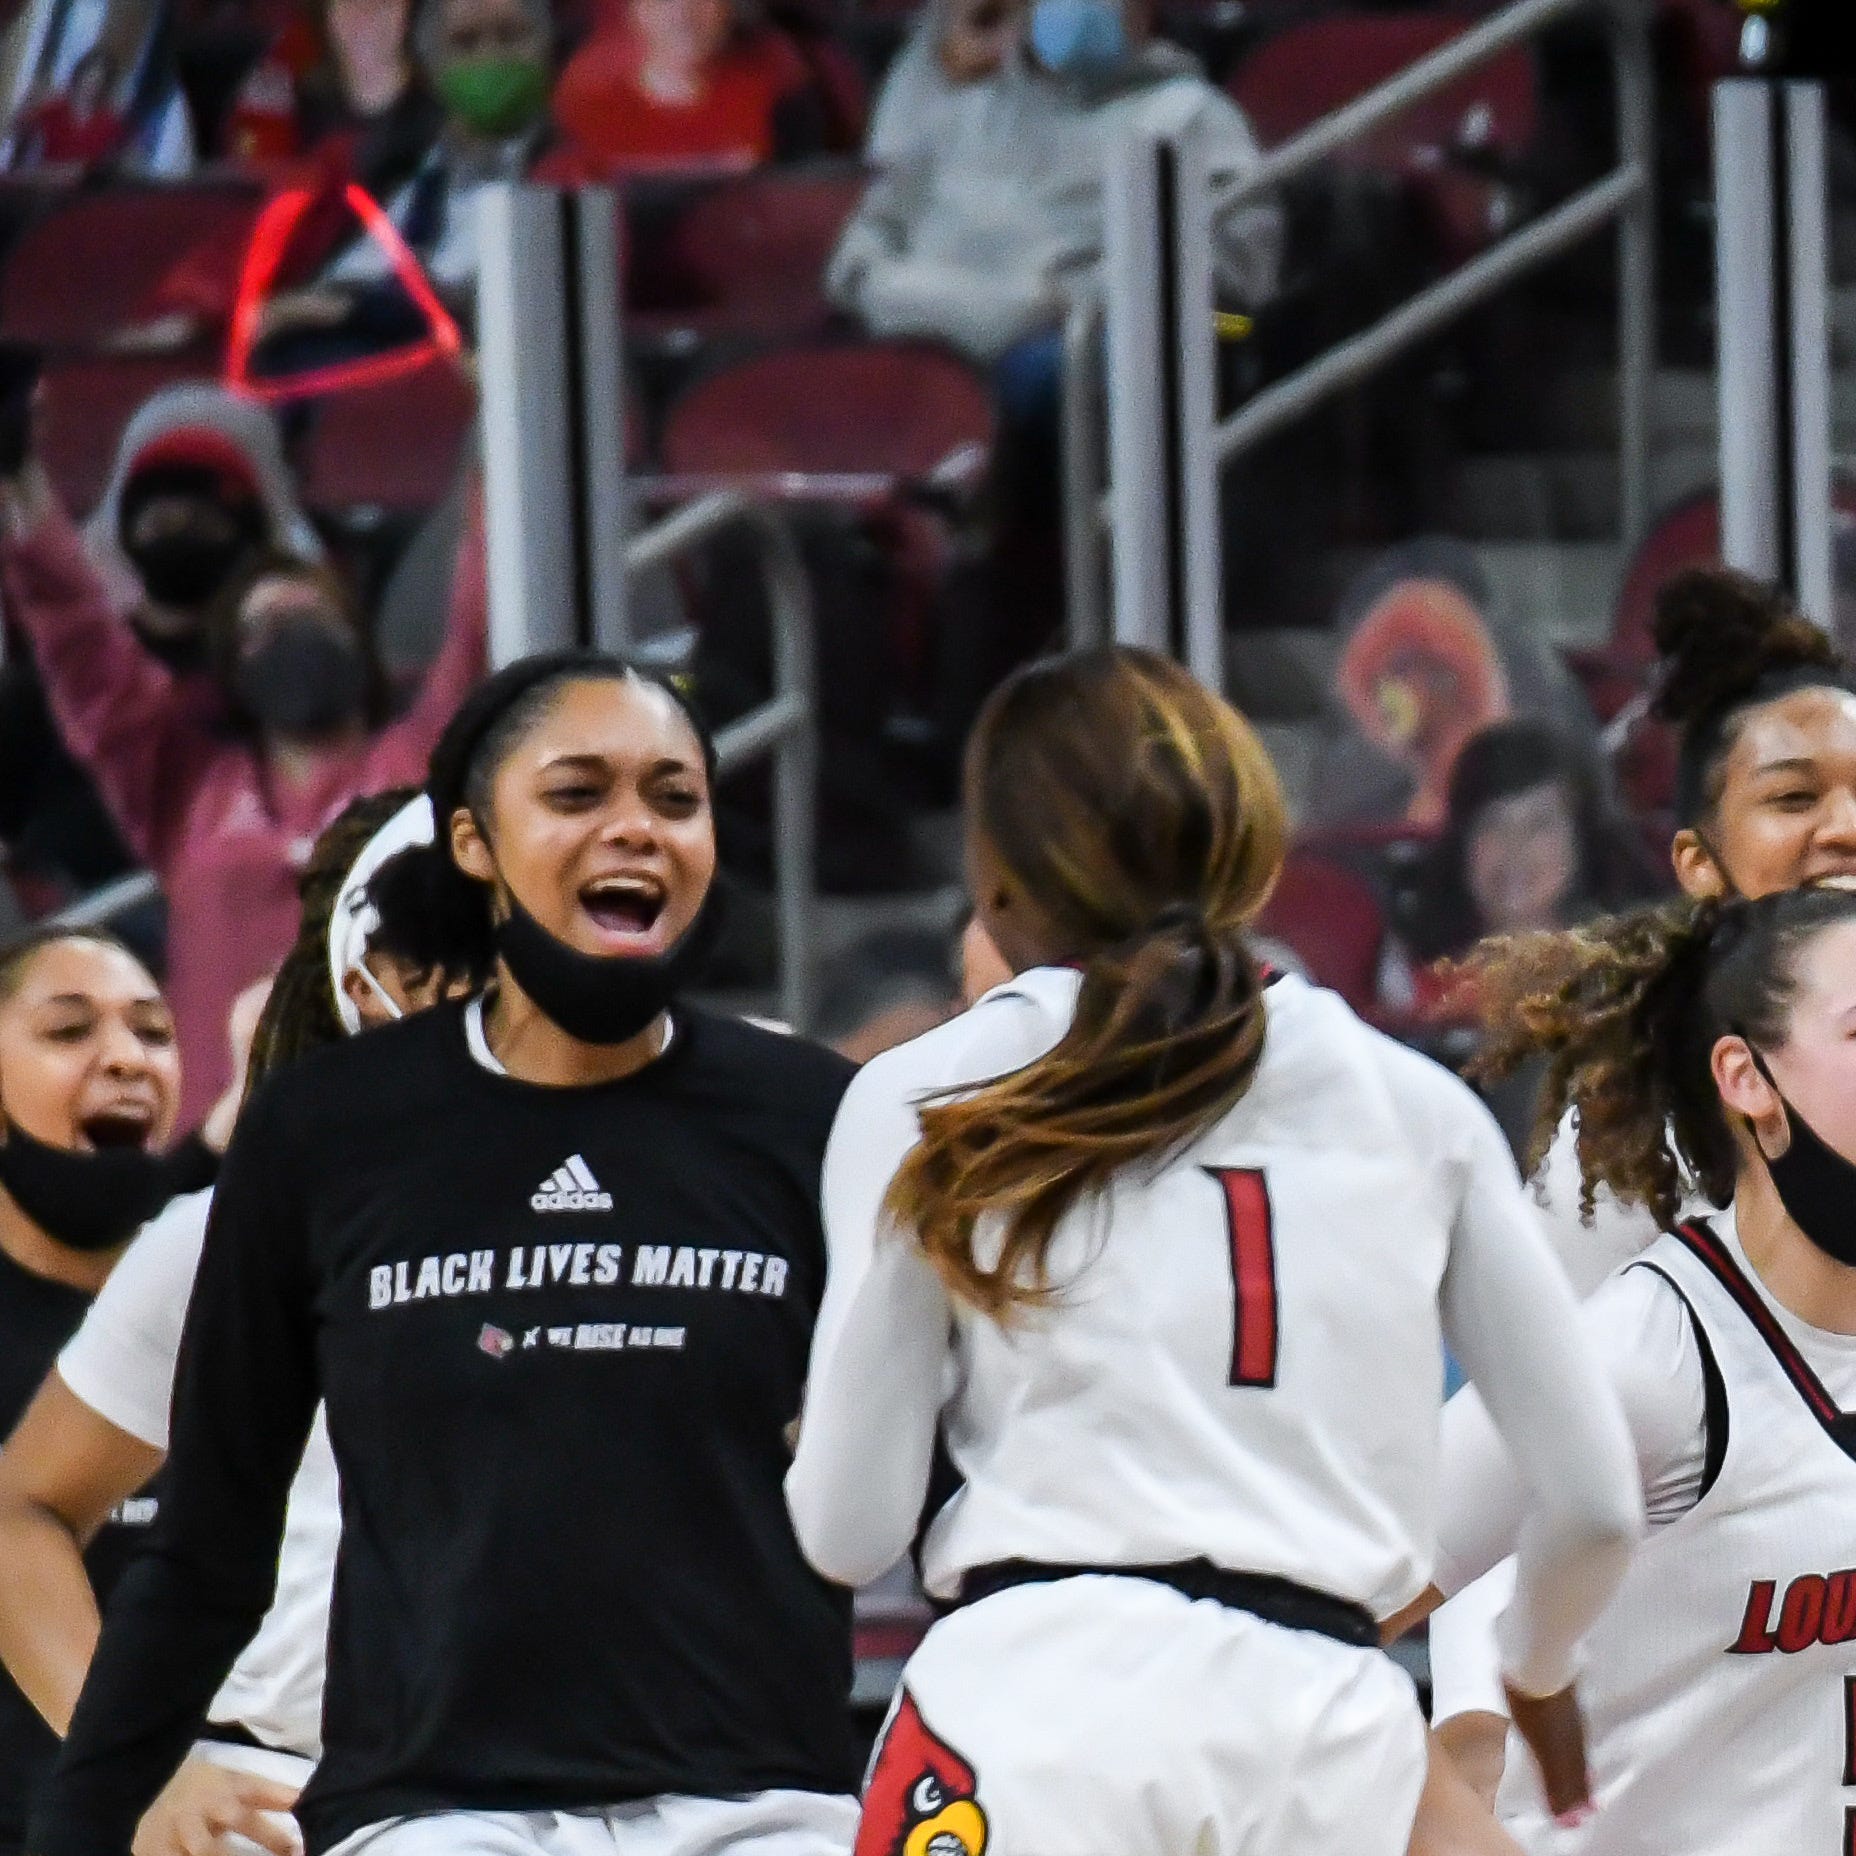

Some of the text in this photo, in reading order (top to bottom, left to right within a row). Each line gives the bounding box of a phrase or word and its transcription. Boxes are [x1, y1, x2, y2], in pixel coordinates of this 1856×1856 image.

[530, 1191, 614, 1213] adidas
[369, 1242, 789, 1310] BLACK LIVES MATTER
[1201, 1165, 1278, 1388] 1
